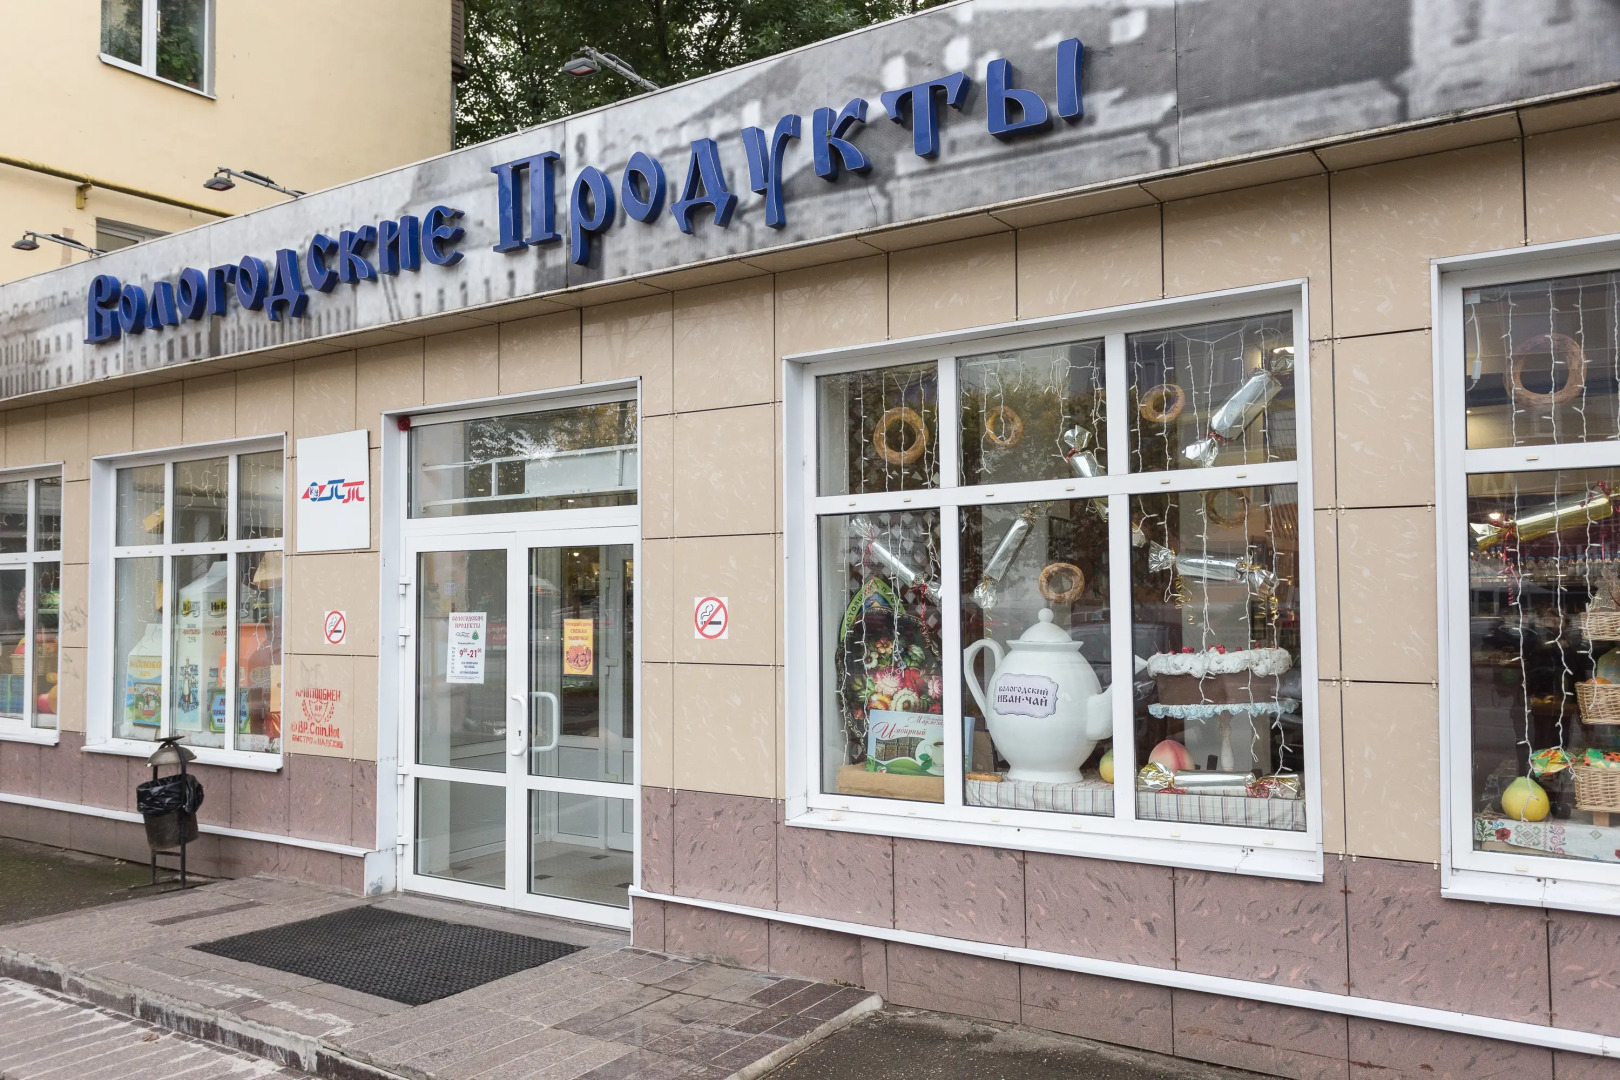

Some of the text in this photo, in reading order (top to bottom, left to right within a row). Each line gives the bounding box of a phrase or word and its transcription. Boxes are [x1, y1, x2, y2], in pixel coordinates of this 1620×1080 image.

[84, 38, 1084, 345] Вологодские Продукты
[998, 685, 1049, 696] ВОЛОГОДСКИЙ
